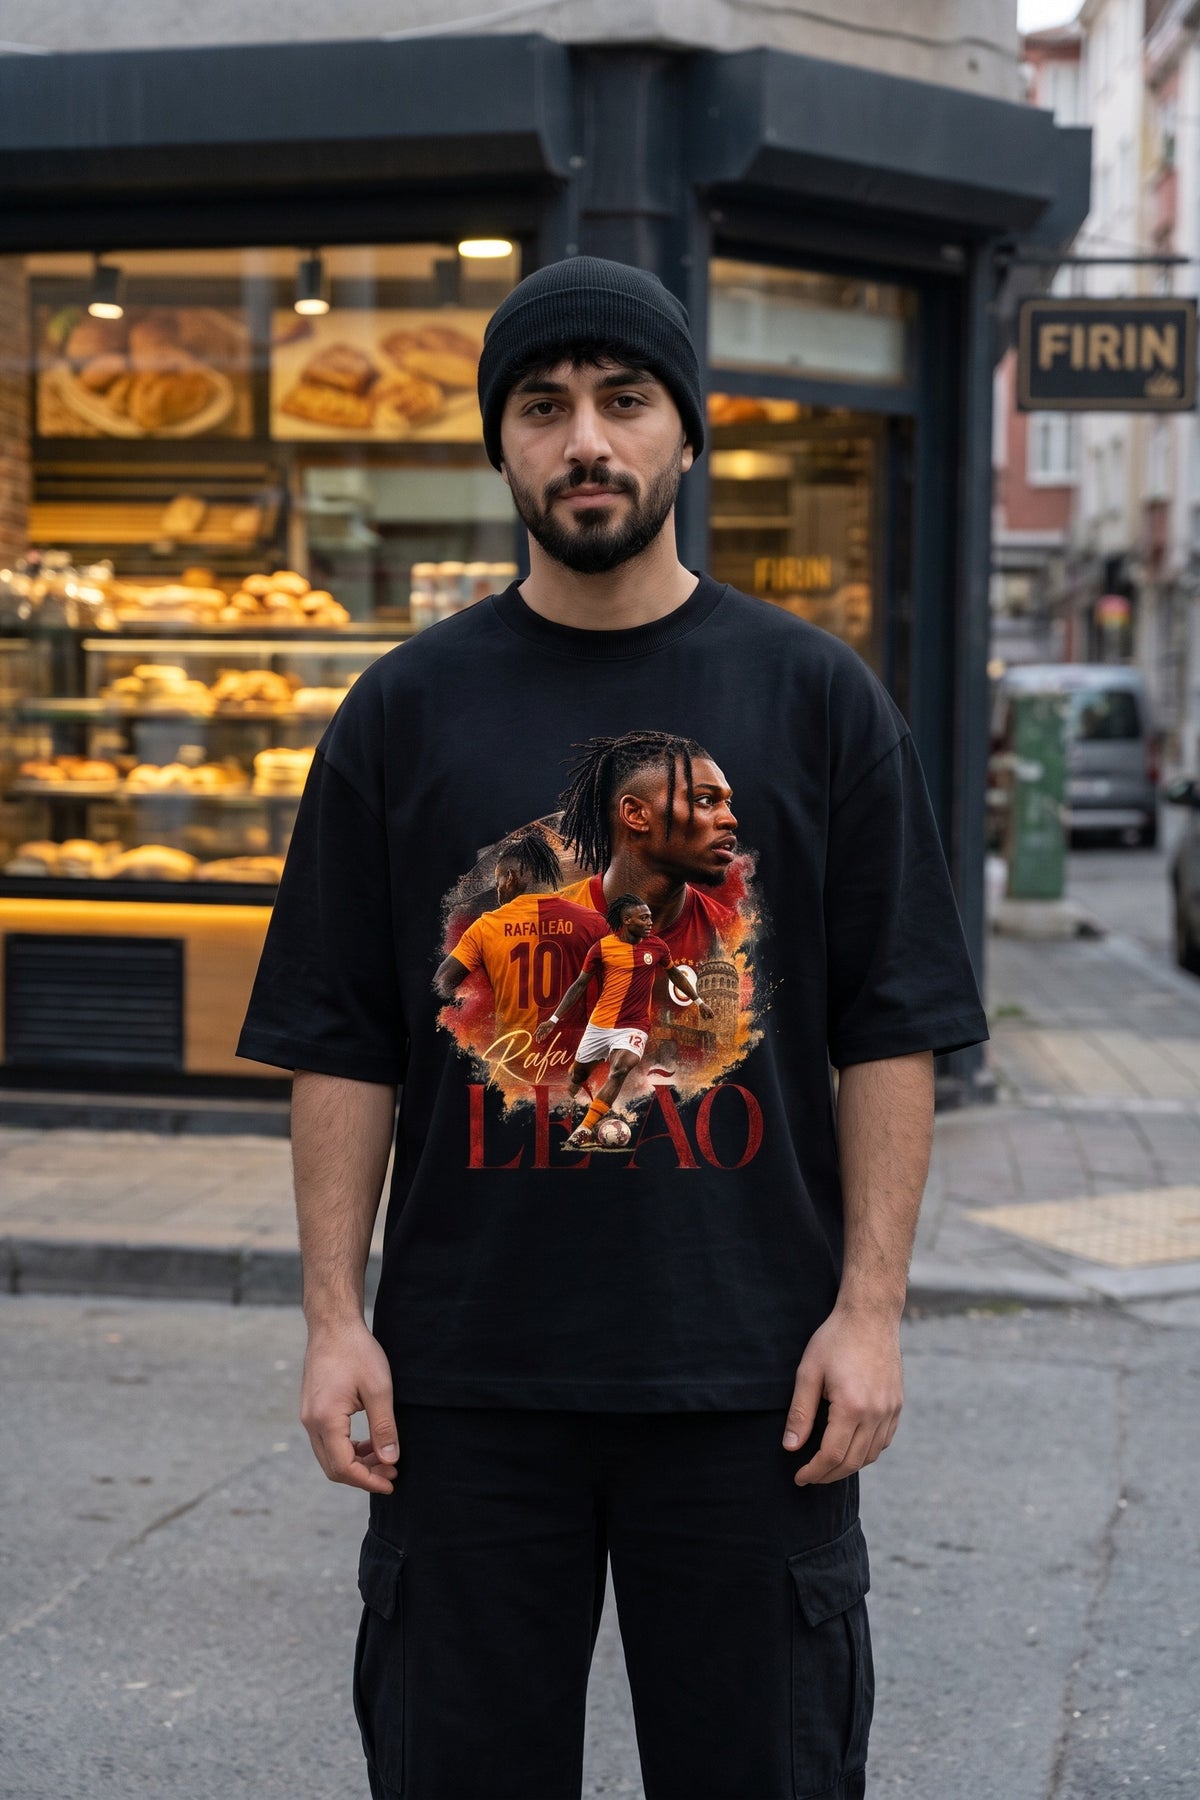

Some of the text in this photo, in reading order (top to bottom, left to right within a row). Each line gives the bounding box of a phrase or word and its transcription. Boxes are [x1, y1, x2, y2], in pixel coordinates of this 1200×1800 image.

[1038, 323, 1178, 371] FIRIN
[504, 918, 574, 937] RAFA LEÃO
[509, 940, 563, 1010] 10
[481, 1029, 574, 1091] Rafa
[465, 1067, 764, 1169] LEÃO
